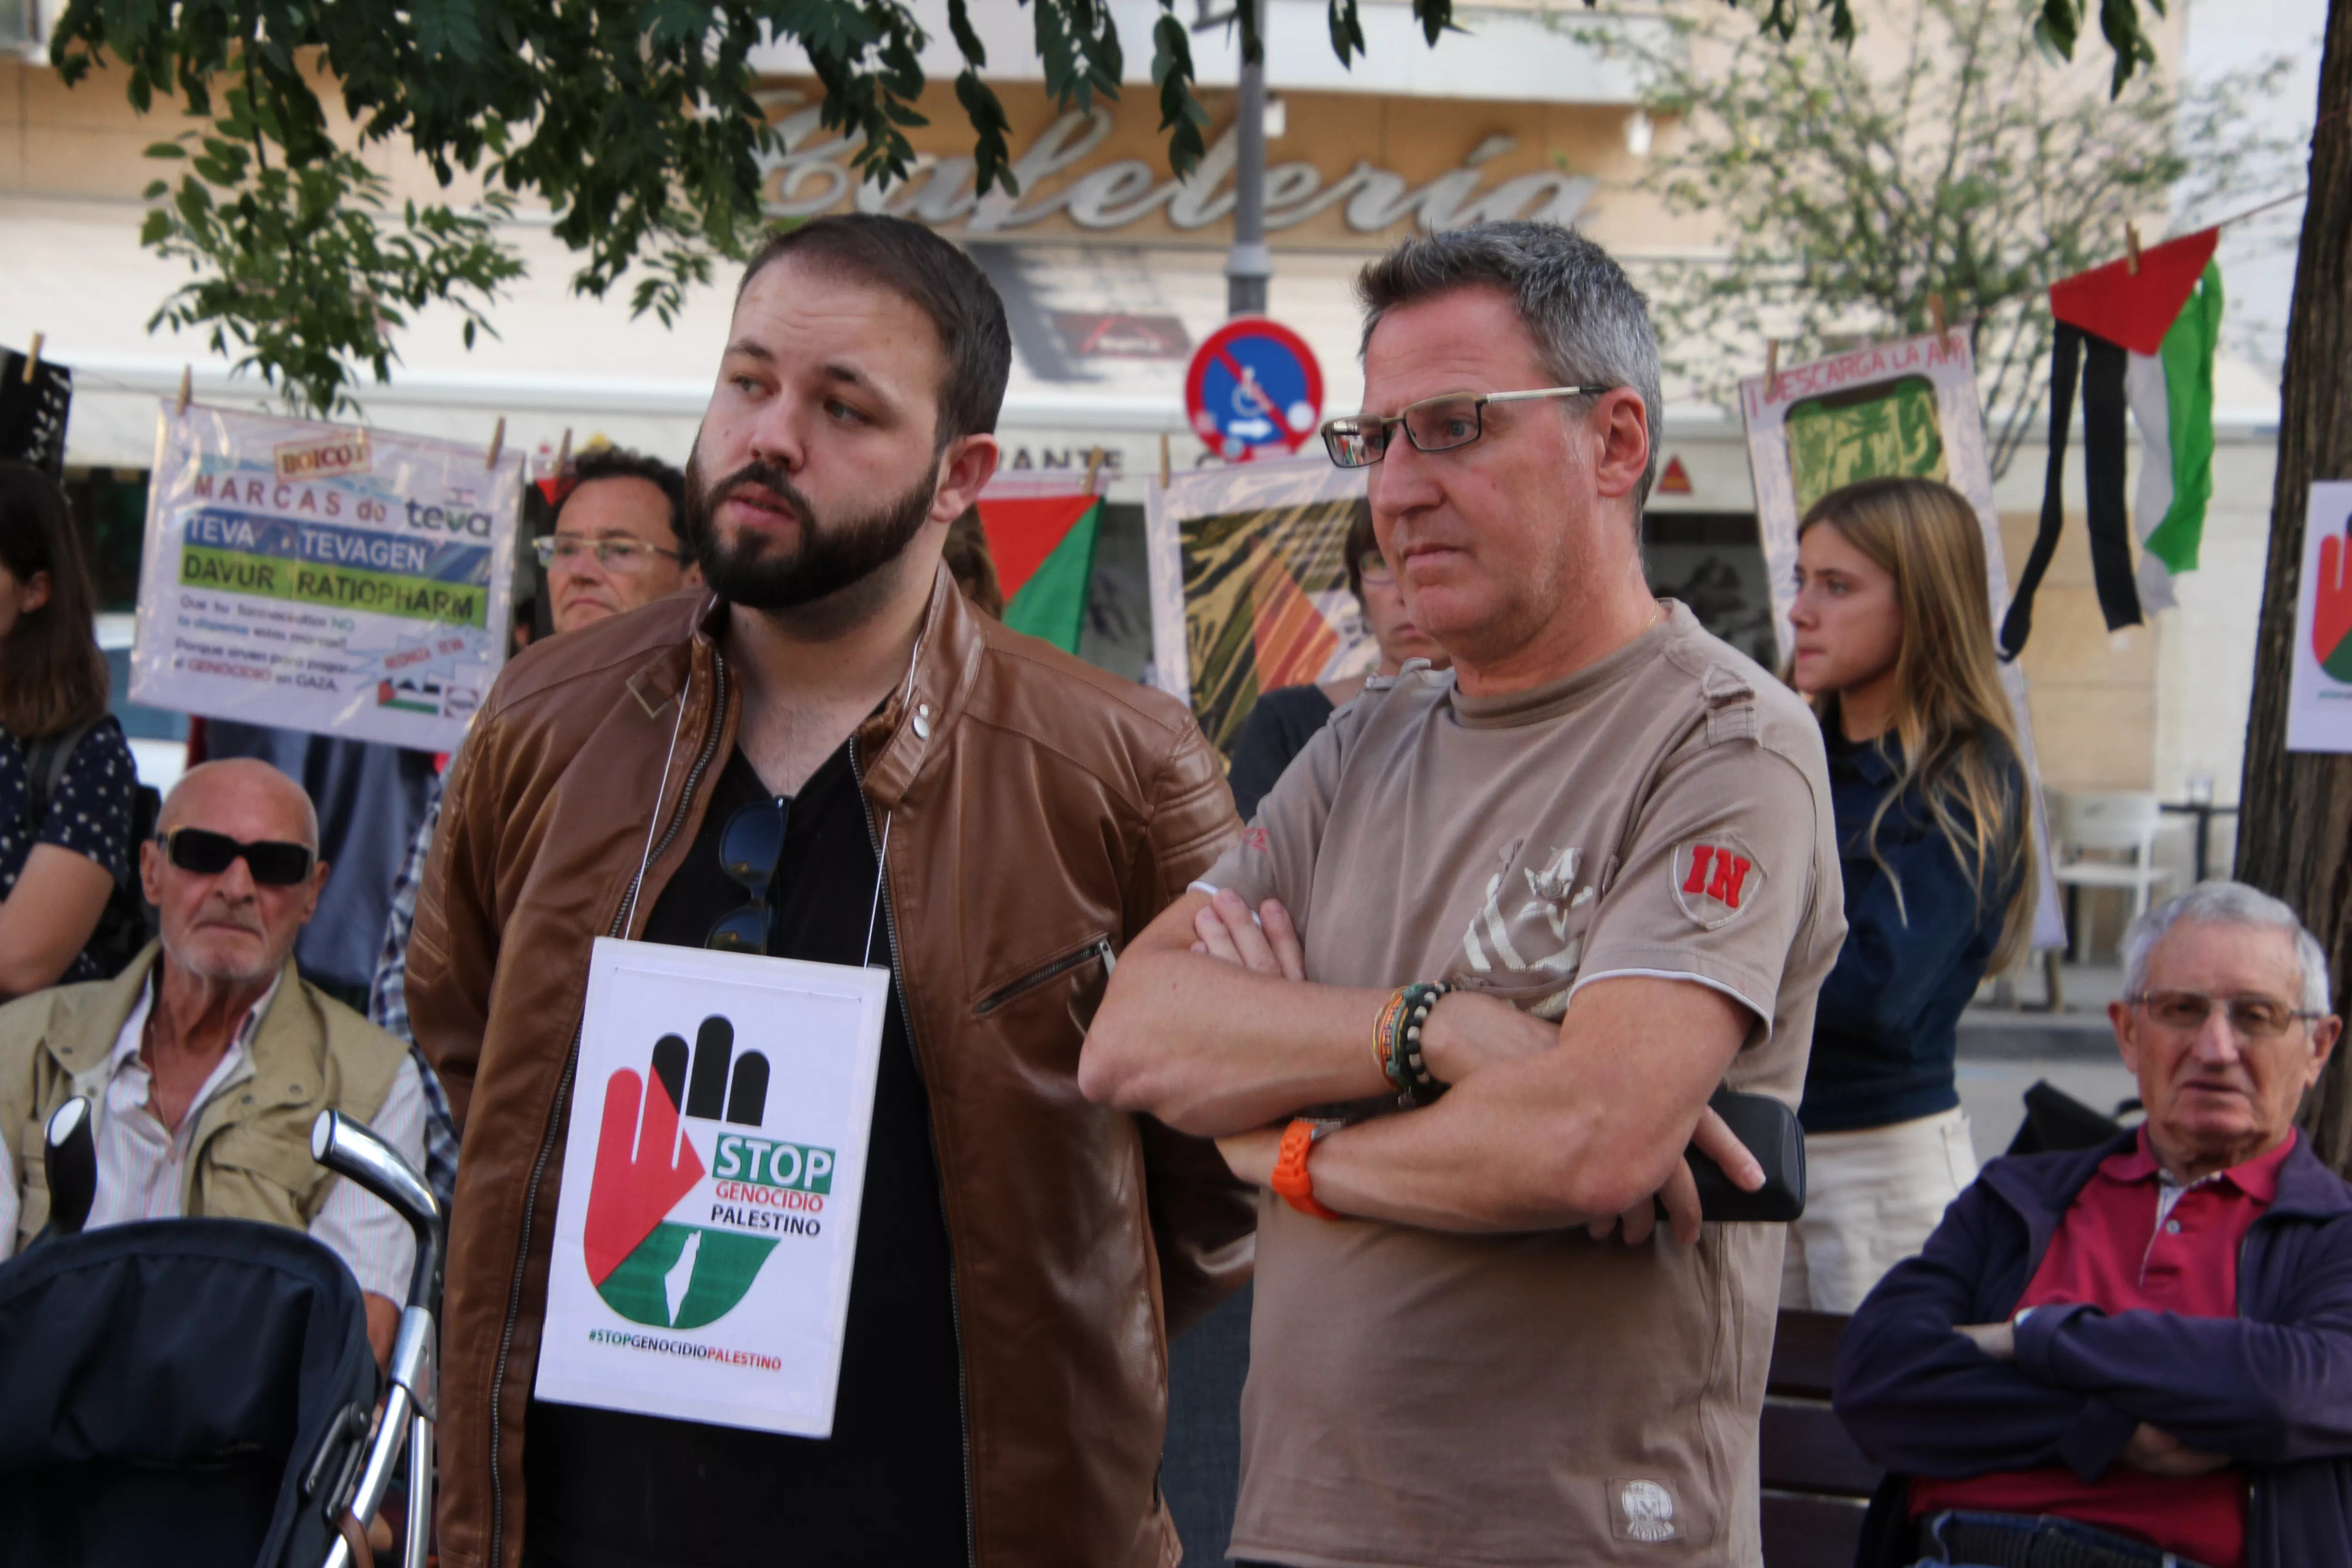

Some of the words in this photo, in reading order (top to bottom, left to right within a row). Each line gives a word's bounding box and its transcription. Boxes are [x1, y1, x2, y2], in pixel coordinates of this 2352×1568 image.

[194, 474, 341, 517] MARCAS
[357, 499, 387, 523] de
[405, 497, 493, 539] teva
[184, 514, 255, 547] TEVA
[301, 530, 427, 572] TEVAGEN
[184, 554, 275, 590] DAVUR
[296, 570, 474, 620] RATIOPHARM
[1682, 844, 1752, 909] IN
[716, 1135, 833, 1191] STOP
[710, 1203, 821, 1237] PALESTINO
[715, 1179, 824, 1213] GENOCIDIO
[588, 1328, 782, 1371] #STOPGENOCIDIOPALESTINO
